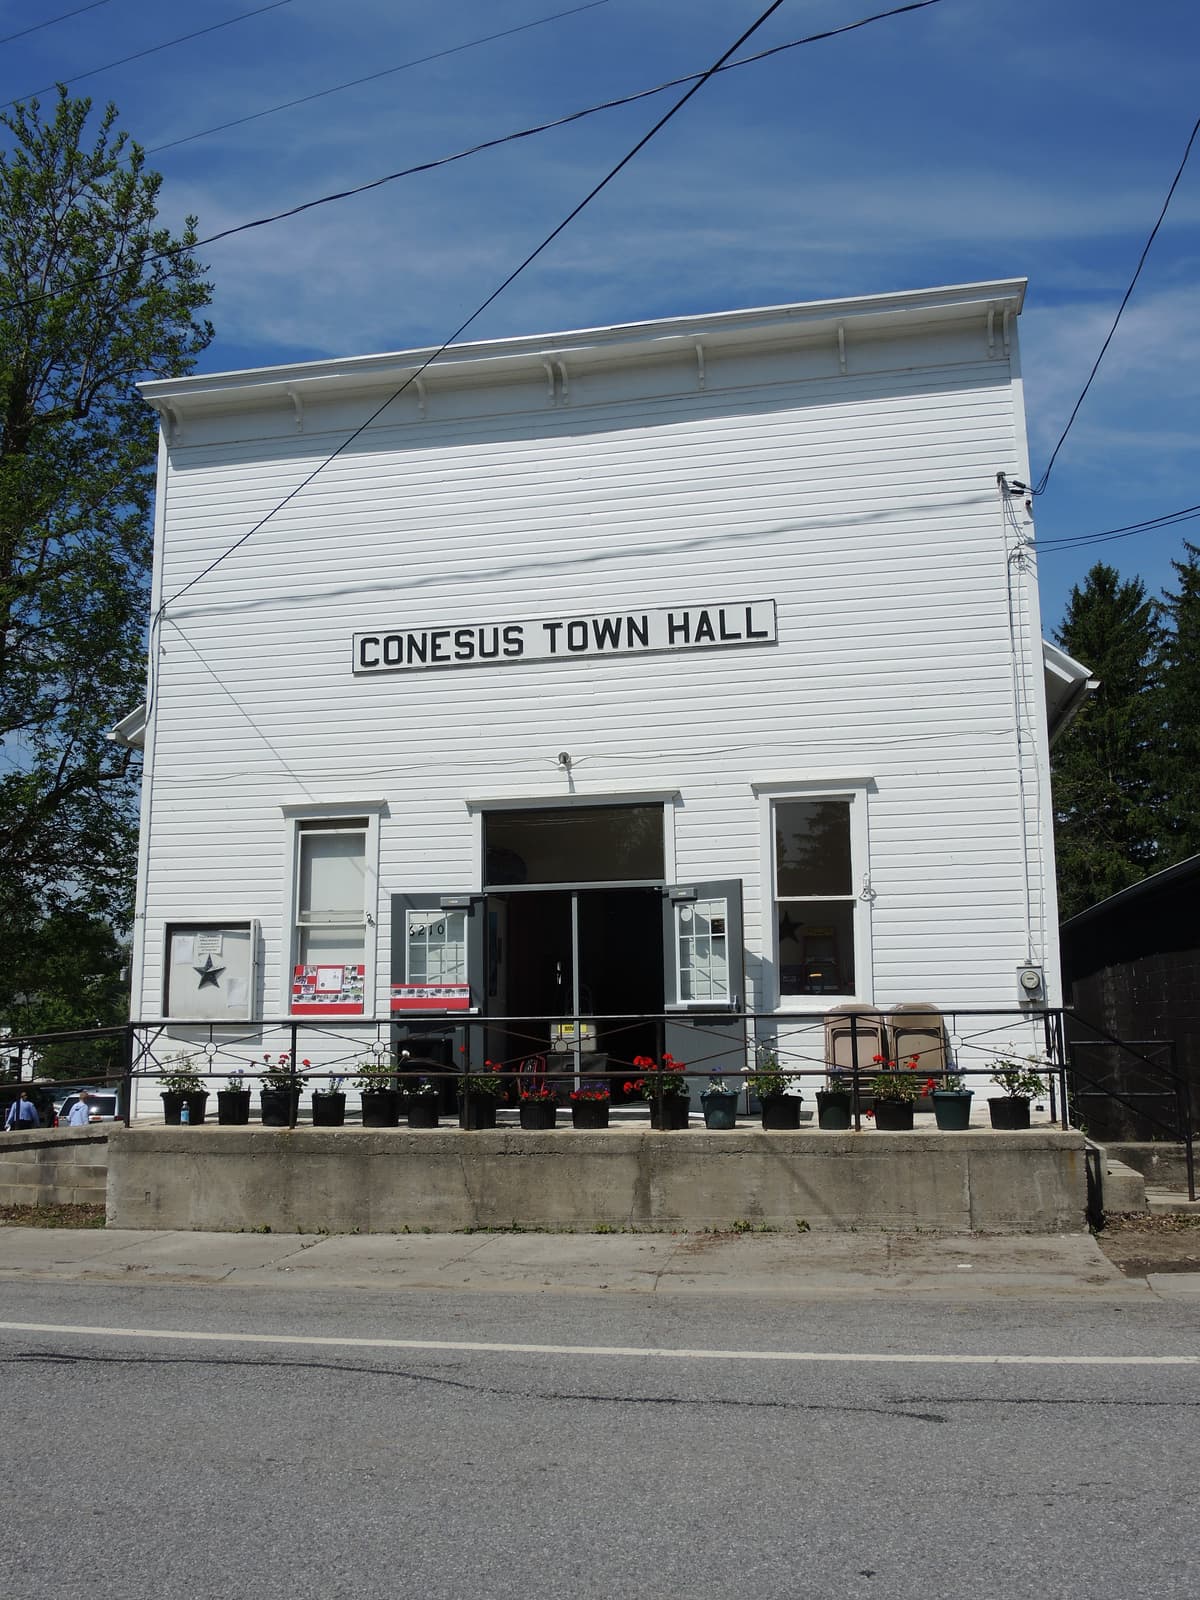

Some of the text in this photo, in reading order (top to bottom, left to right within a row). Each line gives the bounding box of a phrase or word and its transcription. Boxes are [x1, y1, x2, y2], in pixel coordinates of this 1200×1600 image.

[359, 606, 769, 667] CONESUS TOWN HALL
